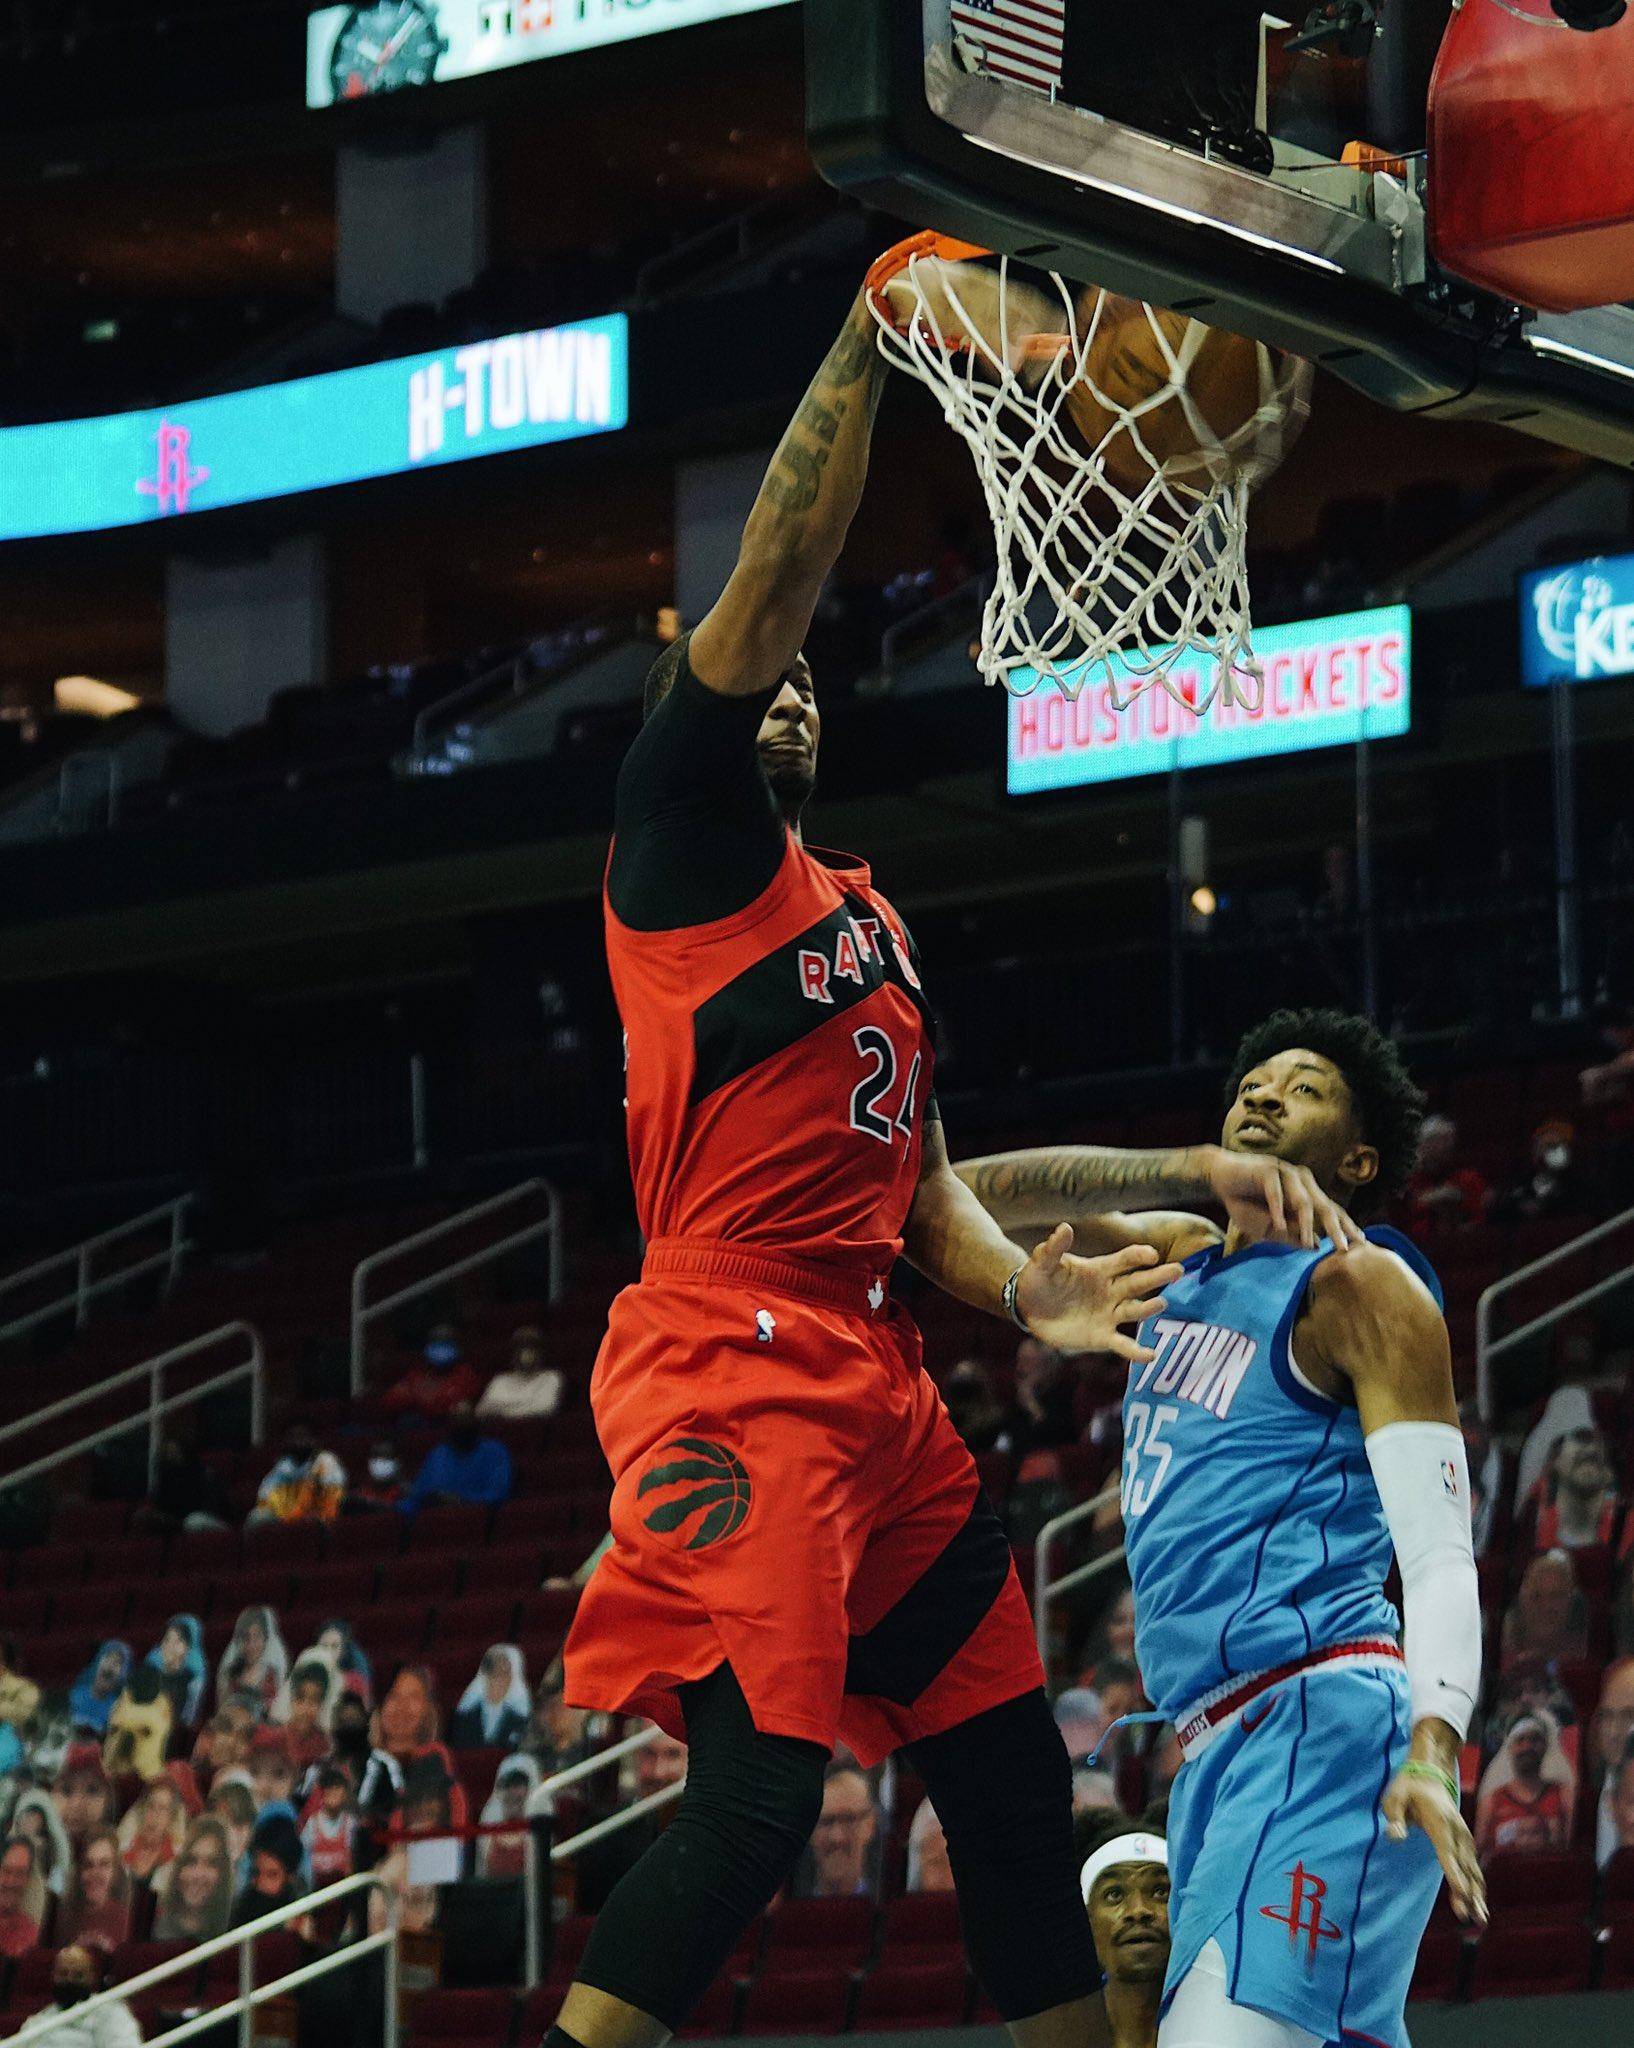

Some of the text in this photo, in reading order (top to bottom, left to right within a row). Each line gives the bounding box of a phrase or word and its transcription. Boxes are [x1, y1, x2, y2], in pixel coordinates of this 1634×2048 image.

[409, 327, 611, 463] H-TOWN
[1014, 636, 1402, 761] HOUSTON ROCKETS
